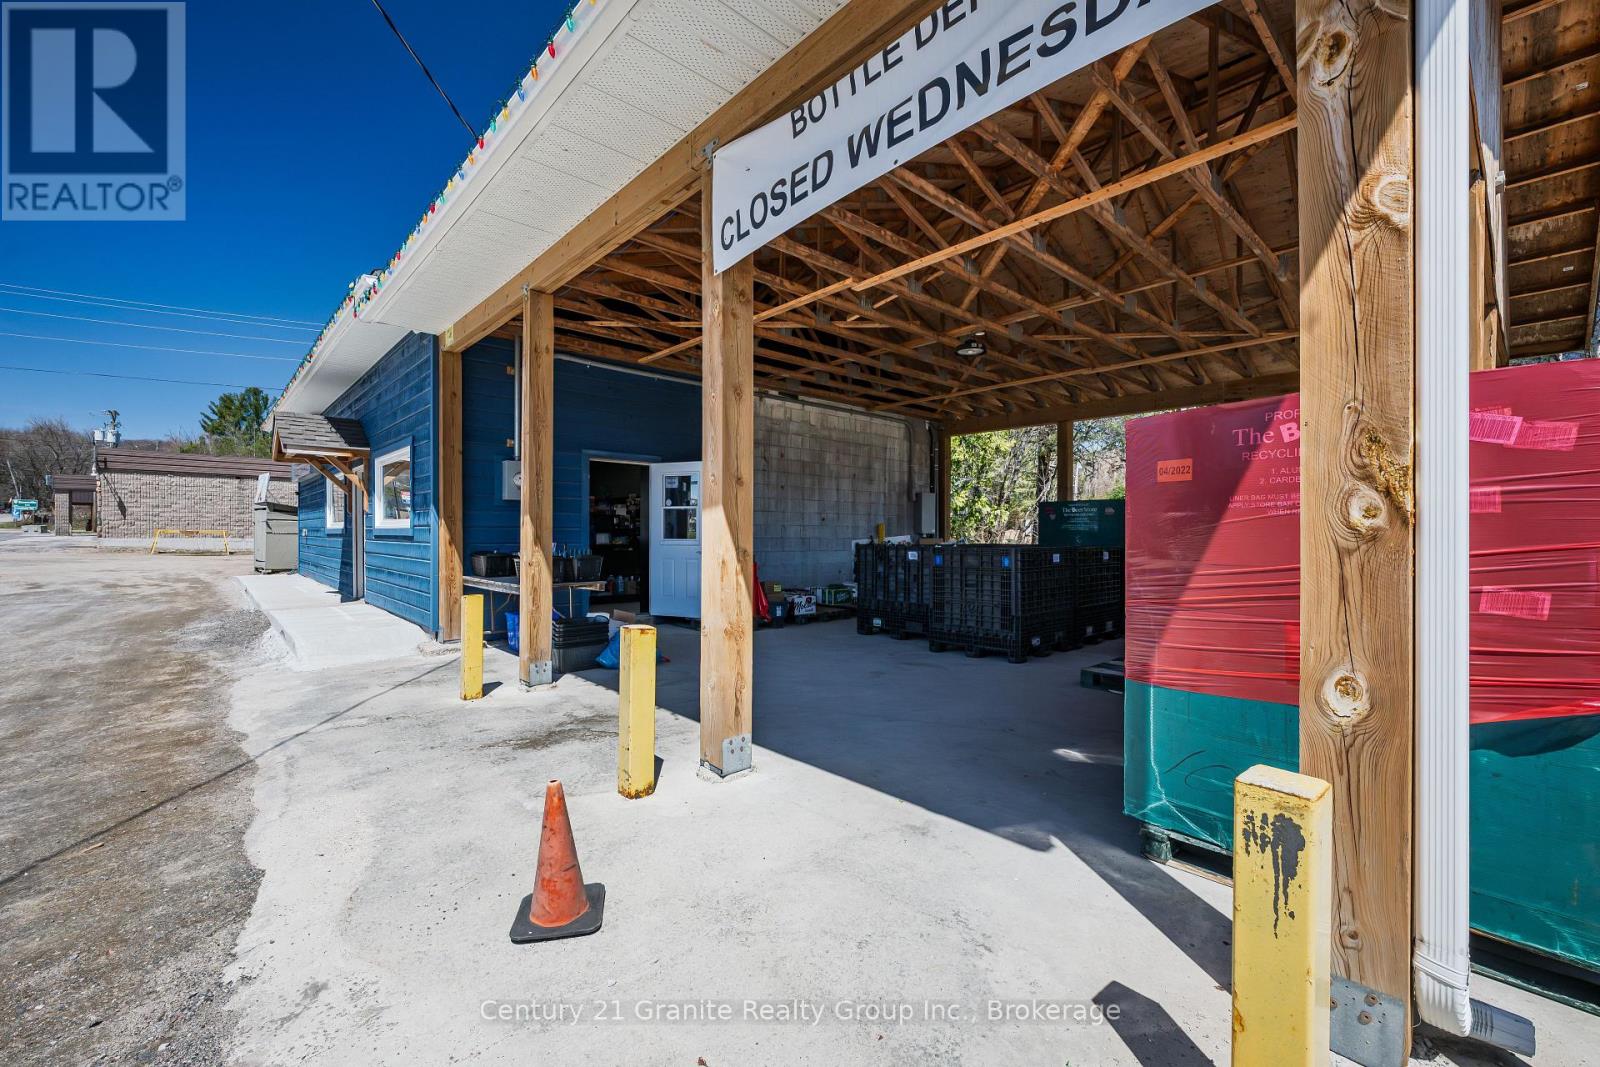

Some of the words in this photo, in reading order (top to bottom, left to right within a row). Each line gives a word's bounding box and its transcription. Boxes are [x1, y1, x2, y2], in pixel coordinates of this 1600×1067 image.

[721, 150, 834, 250] CLOSED
[848, 0, 1151, 169] WEDNESD
[1232, 427, 1275, 446] The
[1159, 465, 1191, 476] 04/2022
